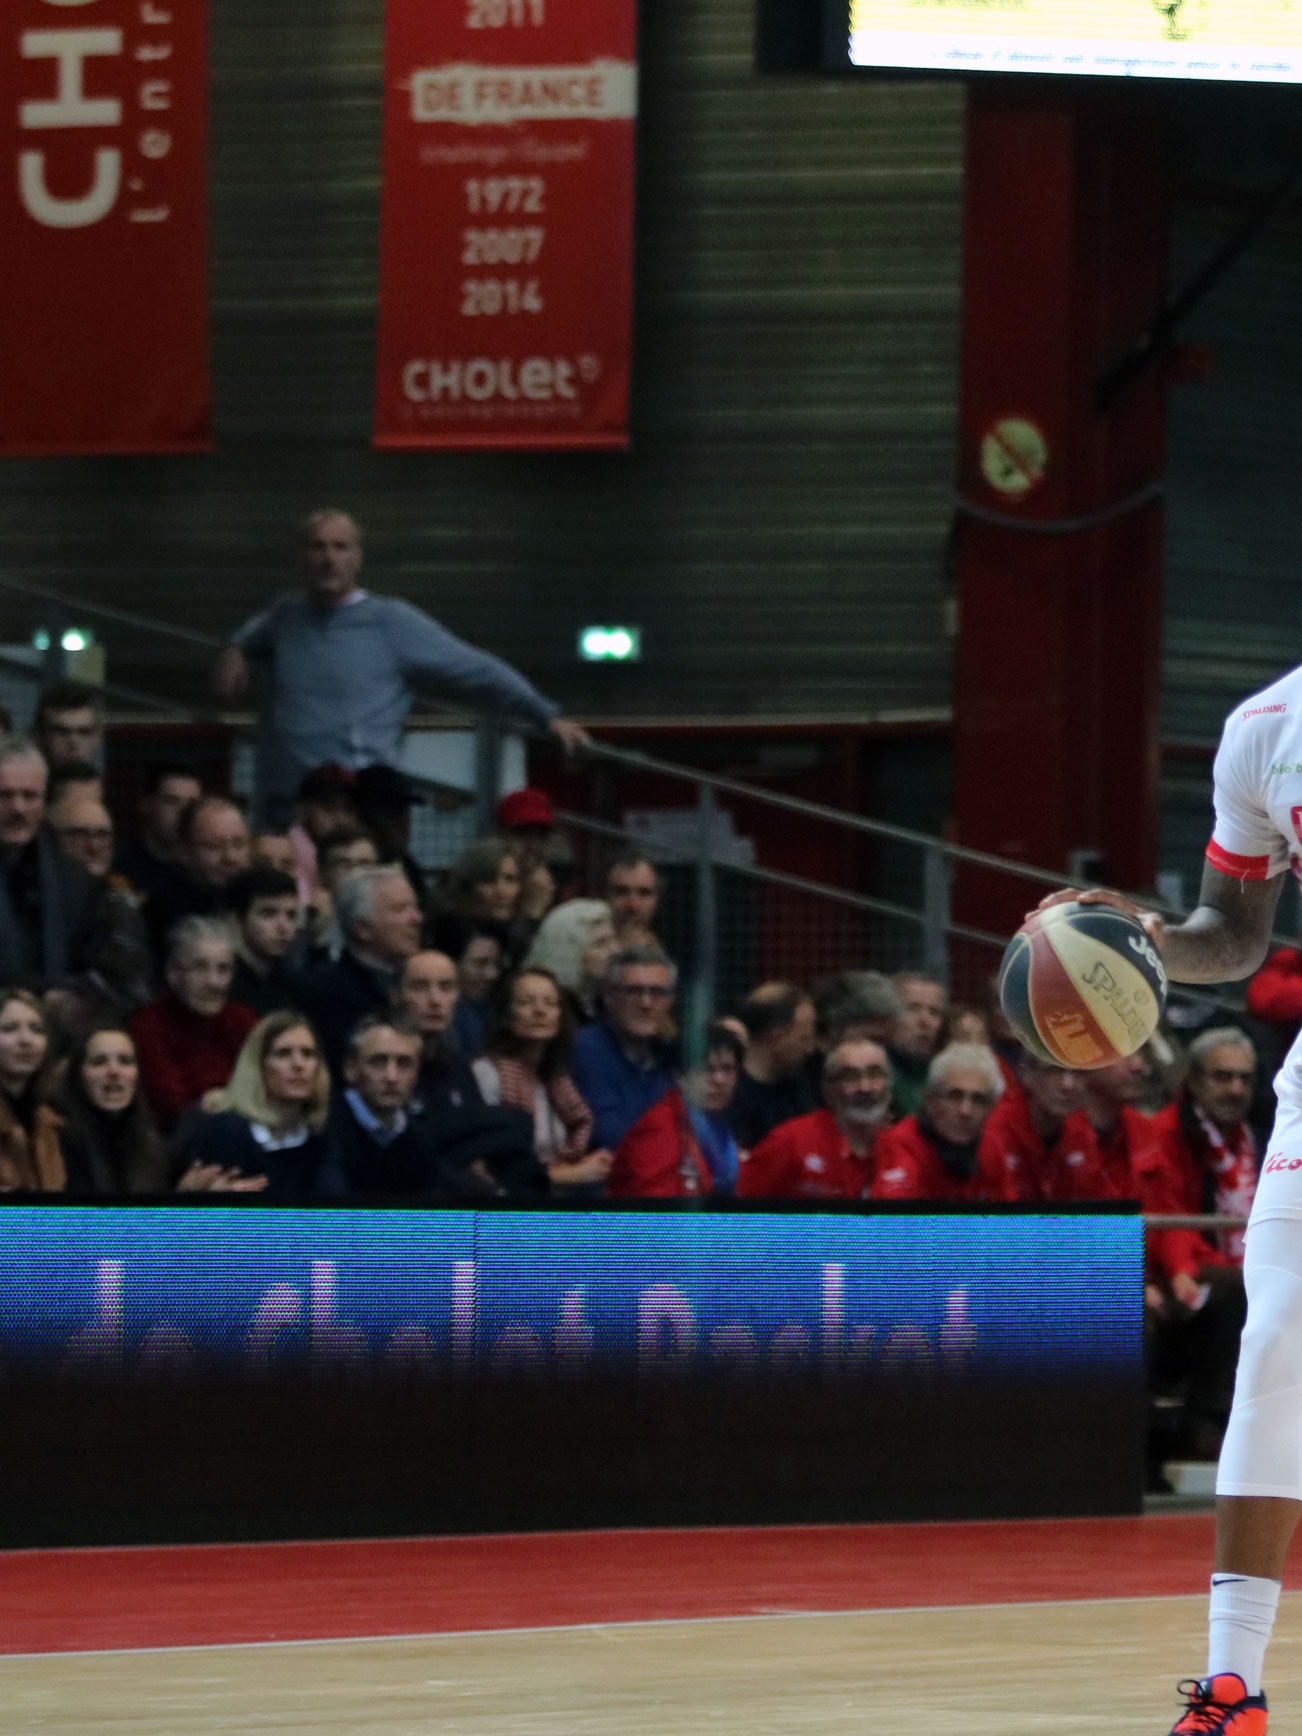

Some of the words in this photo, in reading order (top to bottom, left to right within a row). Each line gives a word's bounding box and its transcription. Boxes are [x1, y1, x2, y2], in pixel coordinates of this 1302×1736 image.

[473, 77, 604, 109] FRANCE
[20, 0, 123, 229] CH
[466, 176, 546, 214] 1972
[462, 227, 545, 266] 2007
[461, 277, 543, 317] 2014
[1243, 703, 1287, 721] SPALDING
